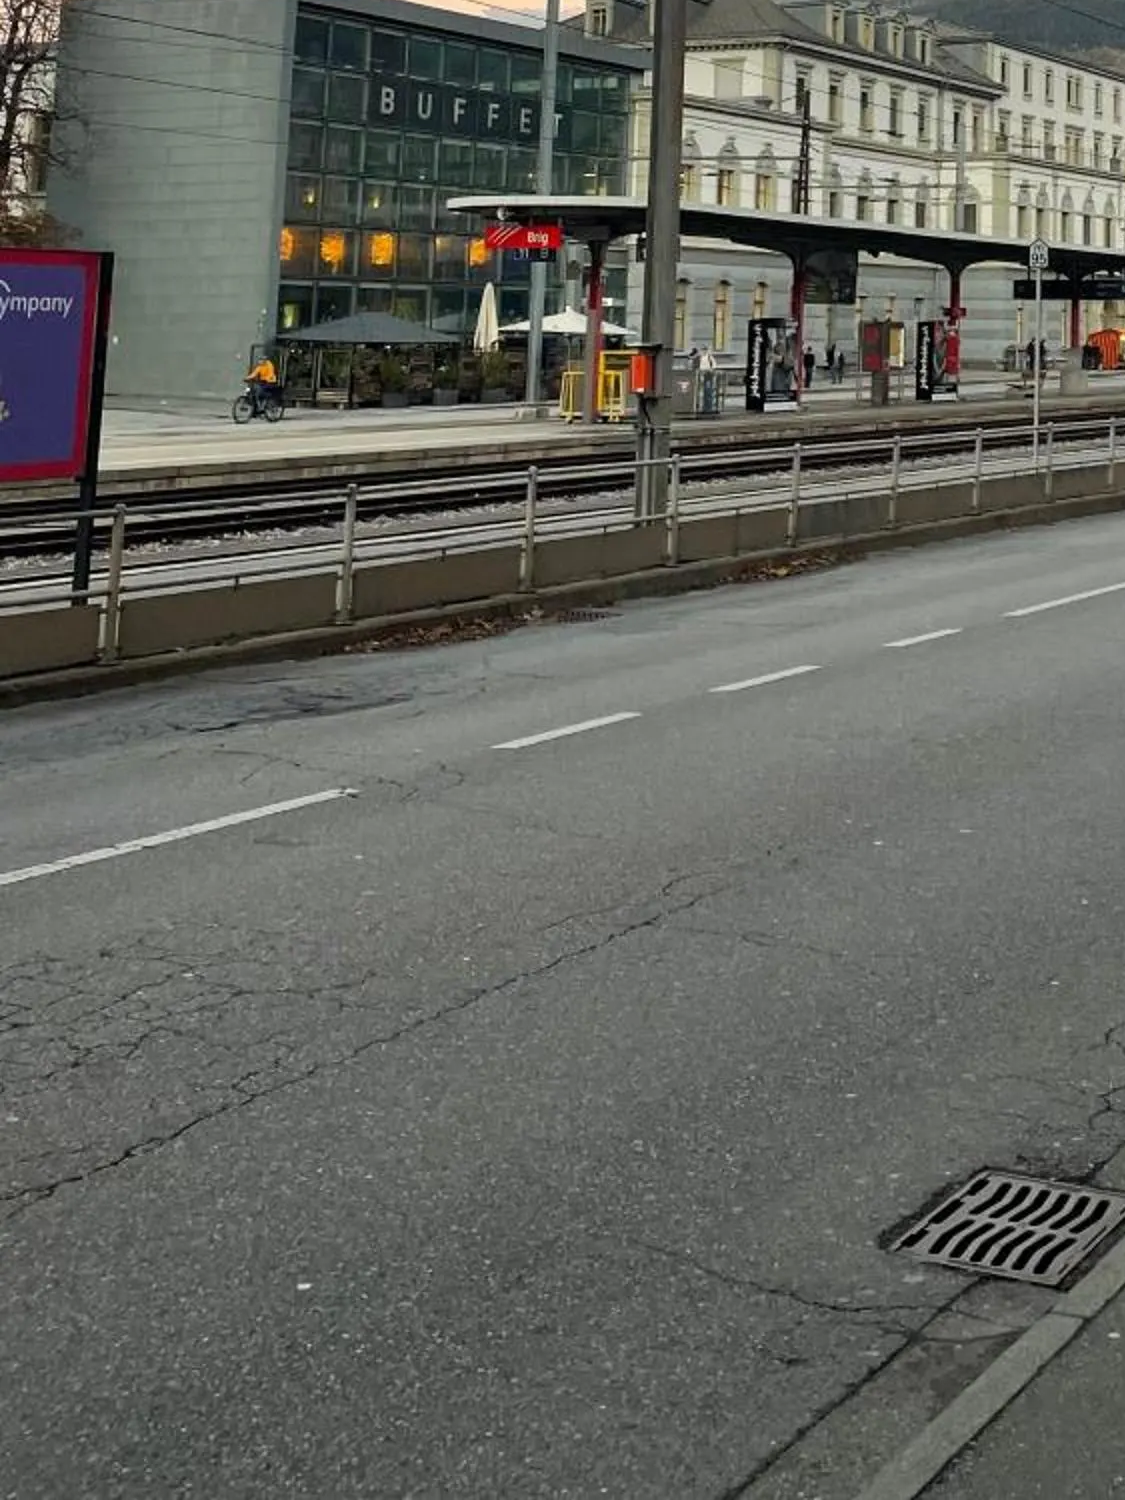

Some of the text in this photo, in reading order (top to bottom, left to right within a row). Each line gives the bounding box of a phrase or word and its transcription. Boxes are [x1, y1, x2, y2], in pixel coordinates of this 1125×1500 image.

[380, 85, 563, 139] BUFFET
[527, 231, 549, 247] Brig
[1031, 253, 1047, 265] 95
